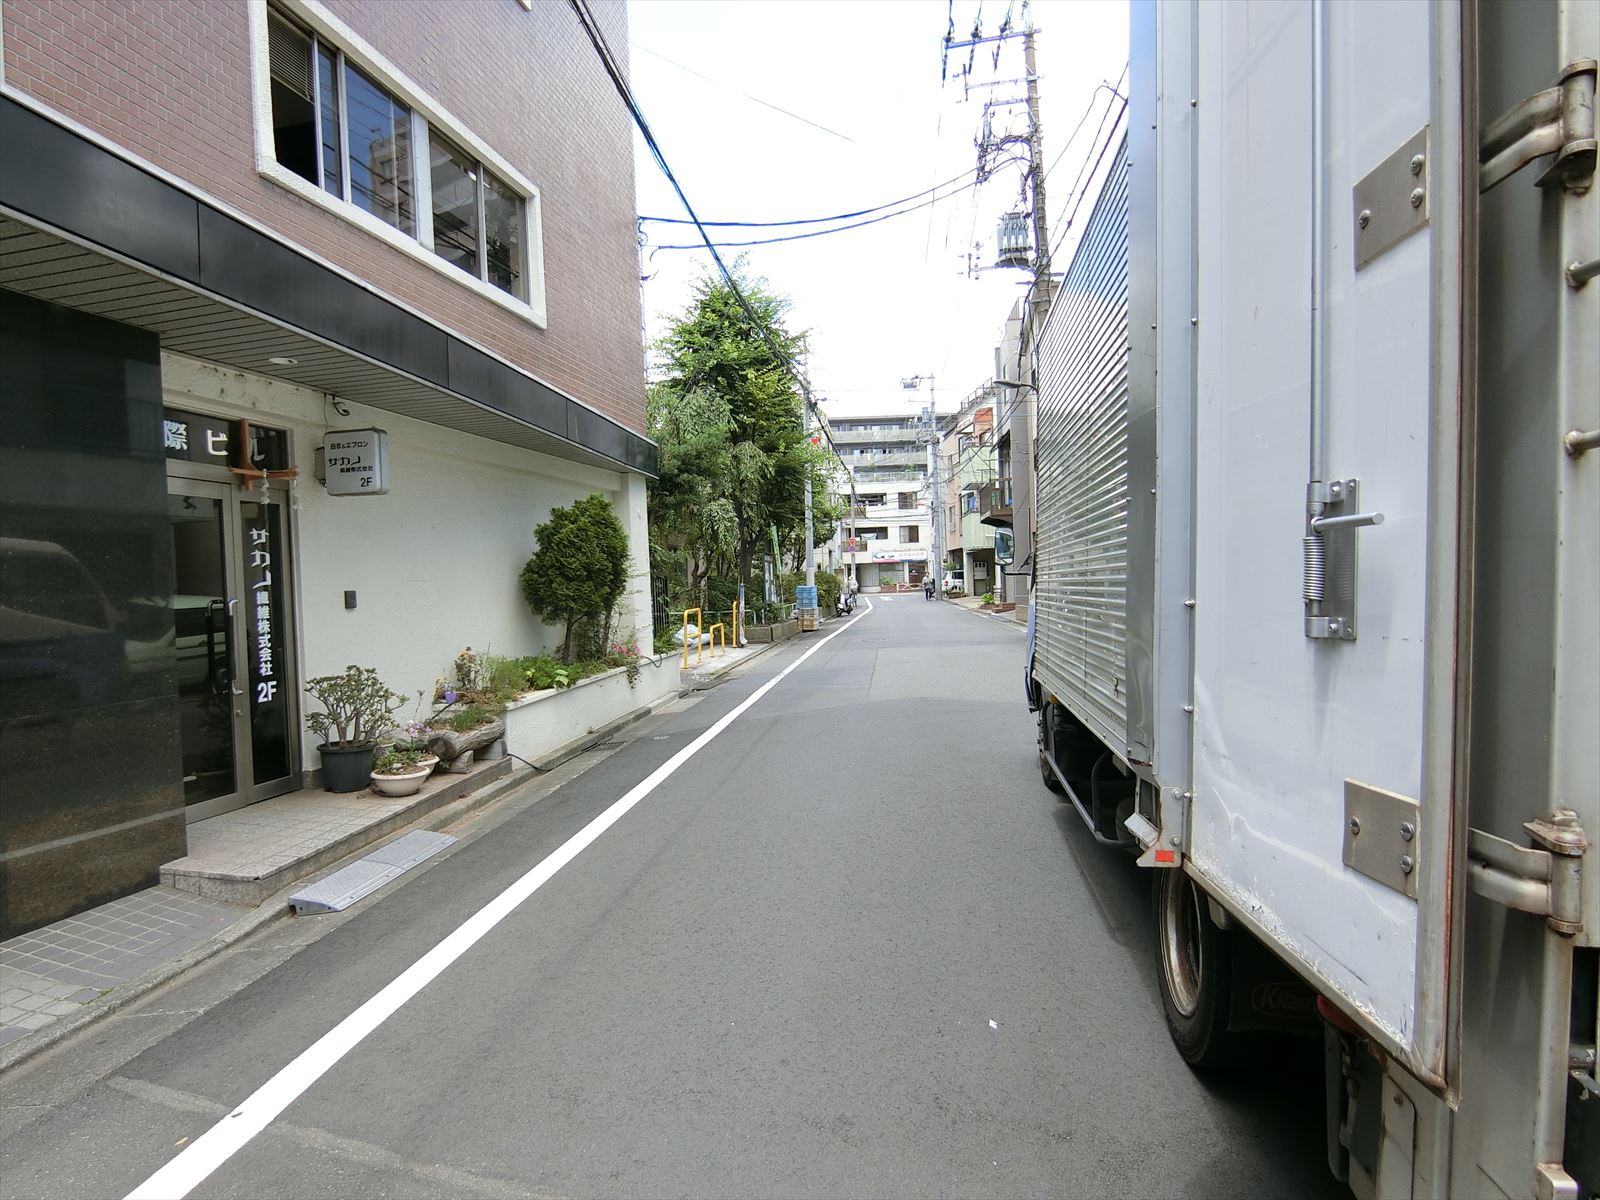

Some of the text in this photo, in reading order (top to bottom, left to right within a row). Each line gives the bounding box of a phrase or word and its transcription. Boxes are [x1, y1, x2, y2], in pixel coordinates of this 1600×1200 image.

[328, 455, 361, 467] サカノ
[360, 477, 373, 487] 2F
[257, 681, 277, 703] 2F
